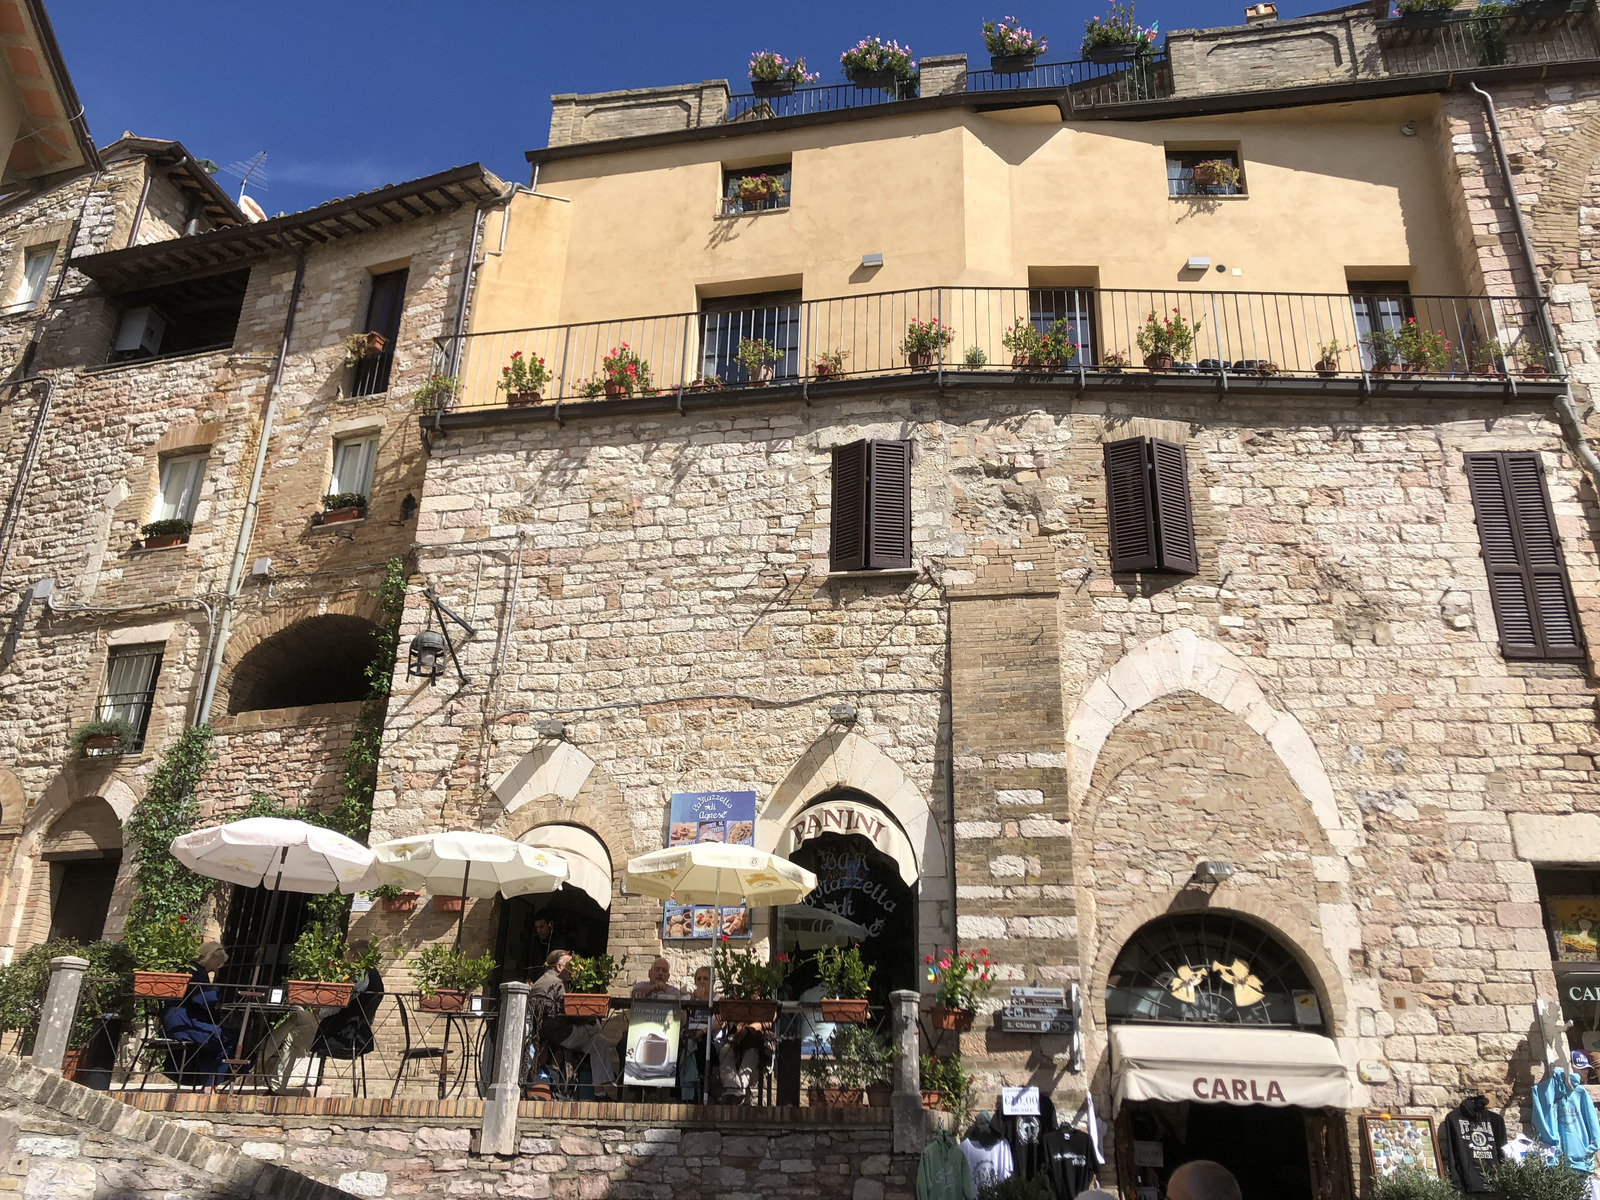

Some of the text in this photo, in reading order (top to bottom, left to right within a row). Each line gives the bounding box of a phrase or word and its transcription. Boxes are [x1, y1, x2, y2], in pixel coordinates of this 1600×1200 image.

[699, 794, 734, 809] Piazzetta
[707, 803, 717, 811] di
[699, 811, 728, 821] Agnese
[790, 809, 886, 845] PANINI
[820, 852, 870, 871] BAR
[836, 896, 855, 918] di
[1015, 1021, 1037, 1029] Chiara
[1192, 1077, 1286, 1102] CARLA
[1458, 1119, 1494, 1136] ITALIA
[1473, 1151, 1493, 1159] ASSISI
